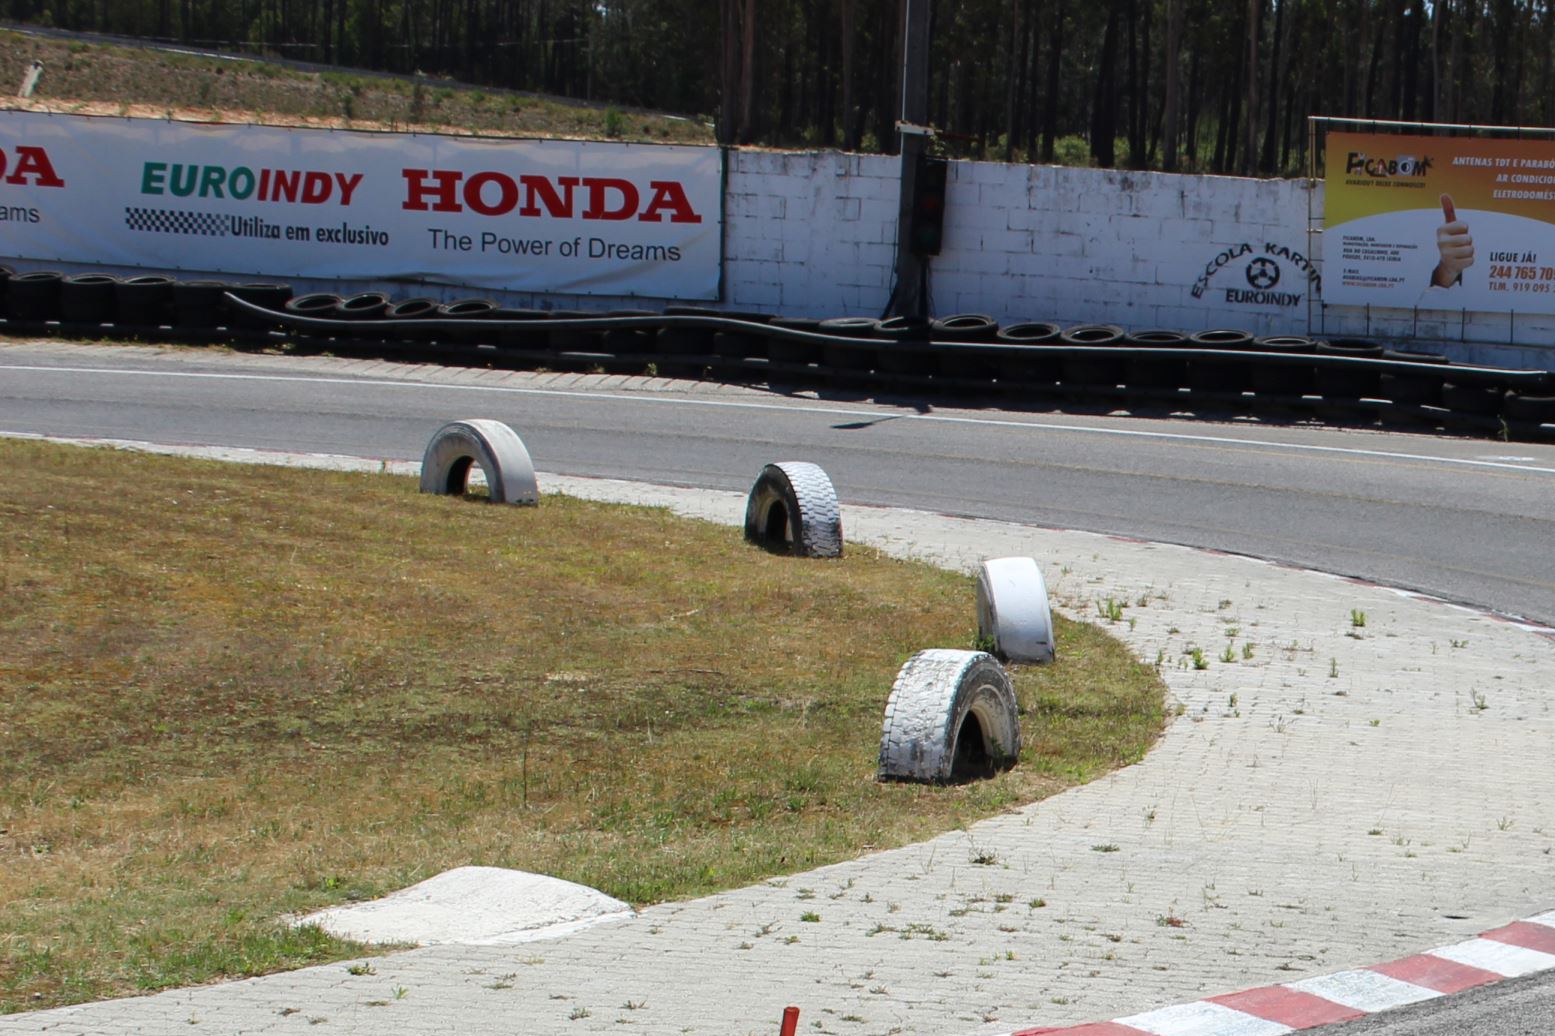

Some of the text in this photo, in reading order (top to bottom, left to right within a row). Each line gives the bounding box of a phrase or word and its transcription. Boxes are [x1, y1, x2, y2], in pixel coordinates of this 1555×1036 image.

[1452, 156, 1492, 166] ANTENAS
[1513, 159, 1518, 167] E
[141, 161, 364, 206] EUROINDY
[1496, 174, 1509, 182] AR
[402, 168, 702, 223] HONDA
[230, 215, 389, 246] Utiliza em exclusivo
[428, 228, 681, 262] The Power of Dreams
[1490, 250, 1537, 263] LIGUE JÁ!
[1191, 242, 1253, 299] ESCOLA
[1489, 266, 1512, 279] 244
[1514, 266, 1537, 280] 765
[1512, 282, 1530, 292] 919
[1532, 283, 1550, 293] 095
[1225, 289, 1303, 307] EUROINDY
